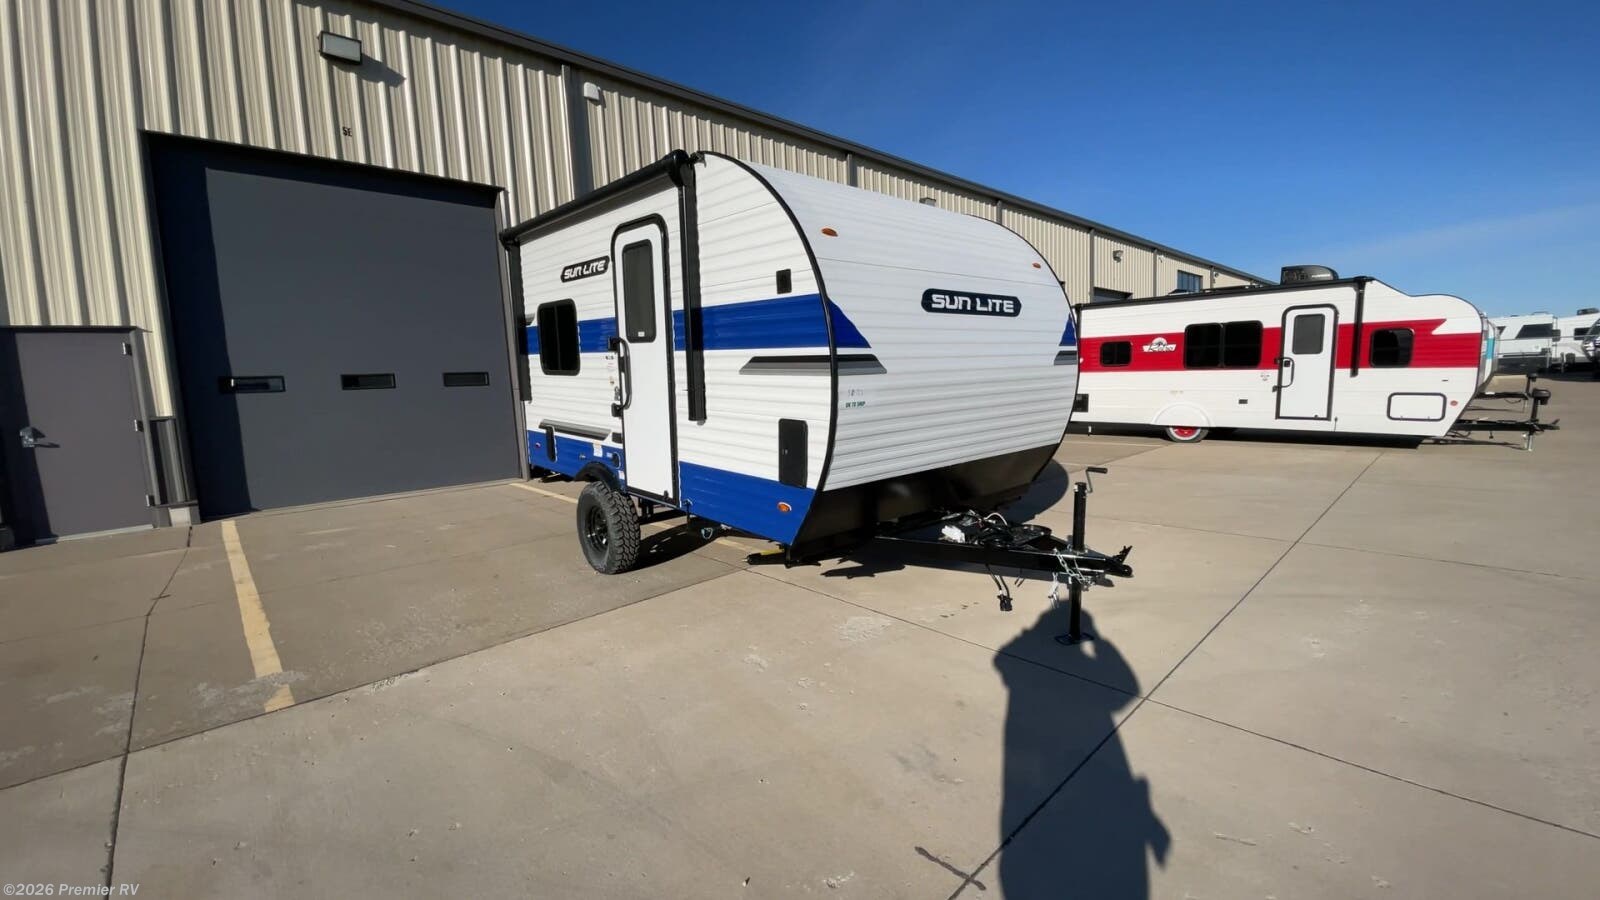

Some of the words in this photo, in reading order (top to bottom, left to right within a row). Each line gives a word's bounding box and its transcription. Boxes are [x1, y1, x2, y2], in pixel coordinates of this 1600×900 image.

[564, 266, 582, 279] SUN
[583, 260, 606, 275] LITE
[931, 294, 971, 311] SUN
[976, 298, 1014, 313] LITE
